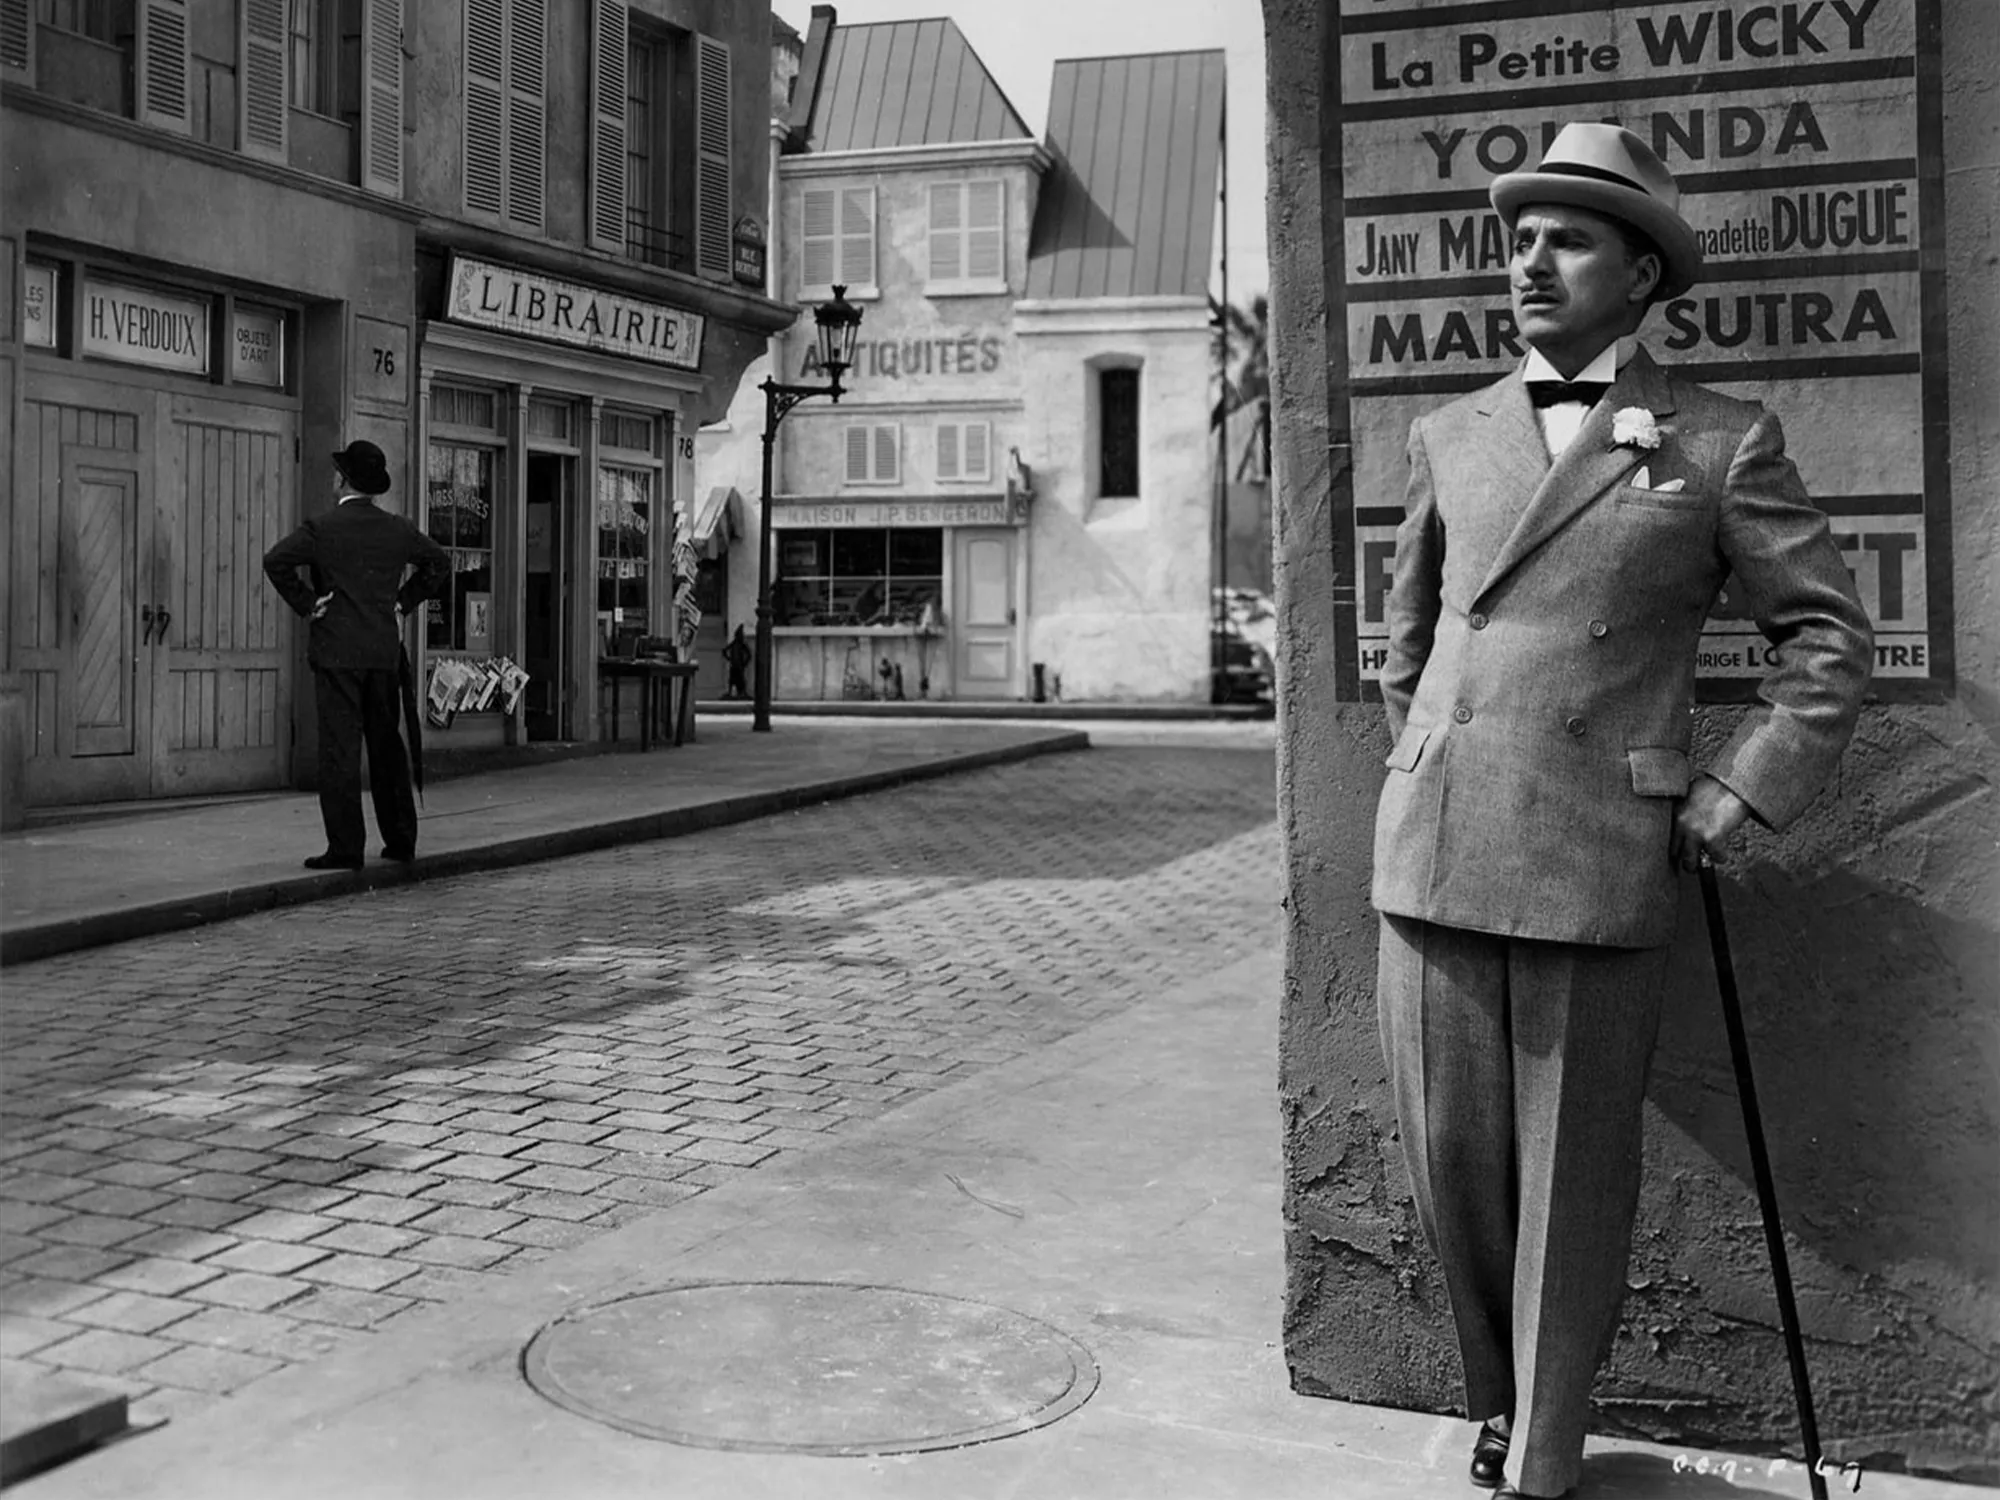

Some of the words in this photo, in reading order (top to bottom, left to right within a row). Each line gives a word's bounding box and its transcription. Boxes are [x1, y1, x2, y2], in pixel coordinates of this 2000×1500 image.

[1371, 41, 1434, 91] La
[1459, 33, 1621, 83] Petite
[1636, 0, 1879, 67] WICKY
[1421, 100, 1829, 180] YONDA
[1439, 214, 1514, 272] MA
[1771, 183, 1909, 252] DUGUÉ
[91, 296, 109, 341] H.
[112, 301, 196, 357] VERDOUX
[236, 327, 272, 348] OBJETS
[480, 275, 679, 351] LIBRAIRIE
[1664, 288, 1898, 350] SUTRA
[240, 344, 270, 364] D'ART
[373, 348, 395, 377] 76
[800, 332, 1001, 380] ATIQUITÉS
[787, 507, 857, 524] MAISON
